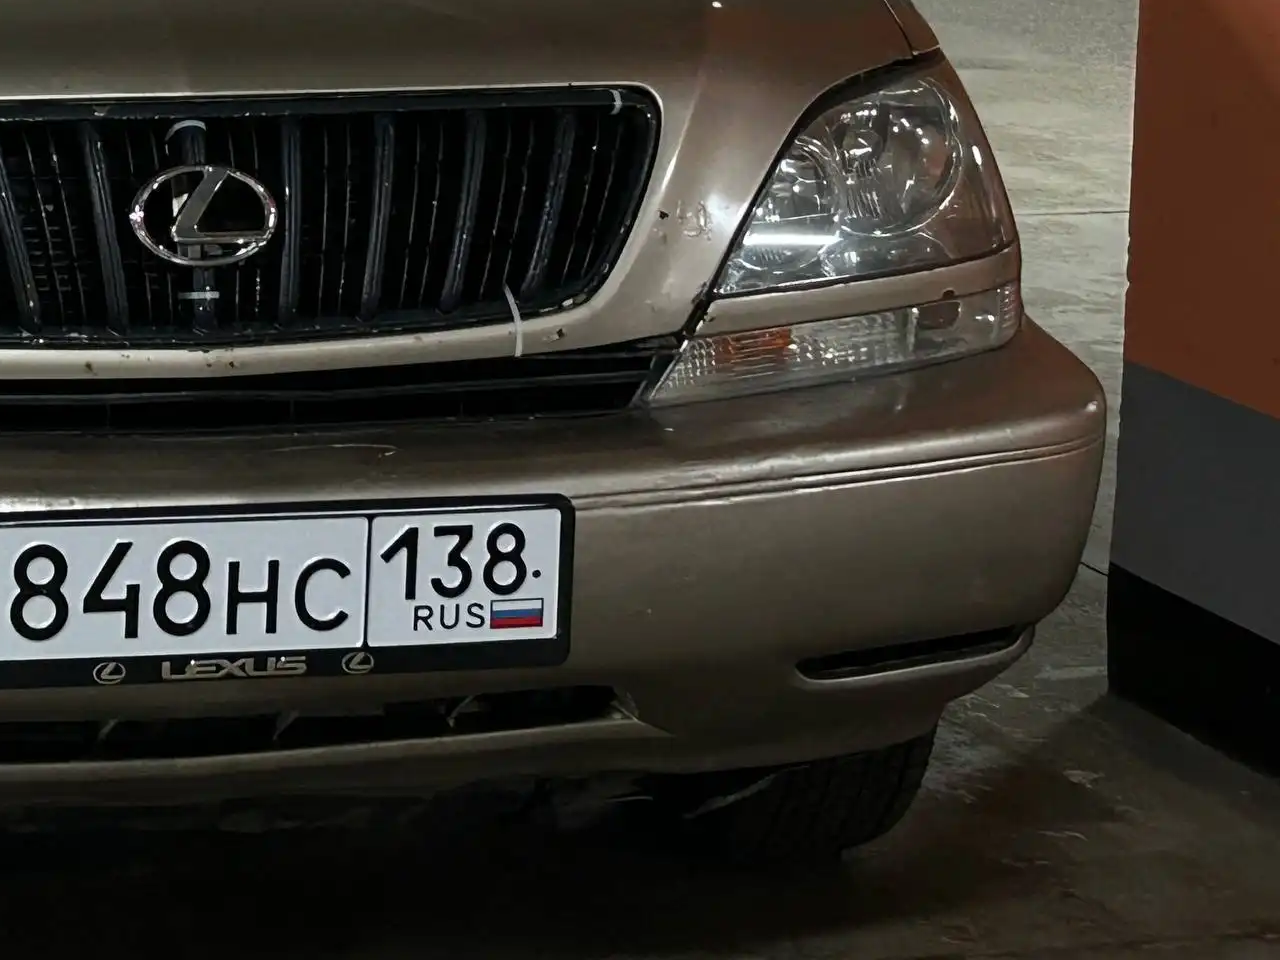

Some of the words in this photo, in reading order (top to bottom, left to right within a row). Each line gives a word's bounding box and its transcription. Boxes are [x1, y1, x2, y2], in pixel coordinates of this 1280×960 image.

[380, 522, 528, 601] 138
[413, 602, 486, 631] RUS
[161, 655, 307, 681] LEXUS
